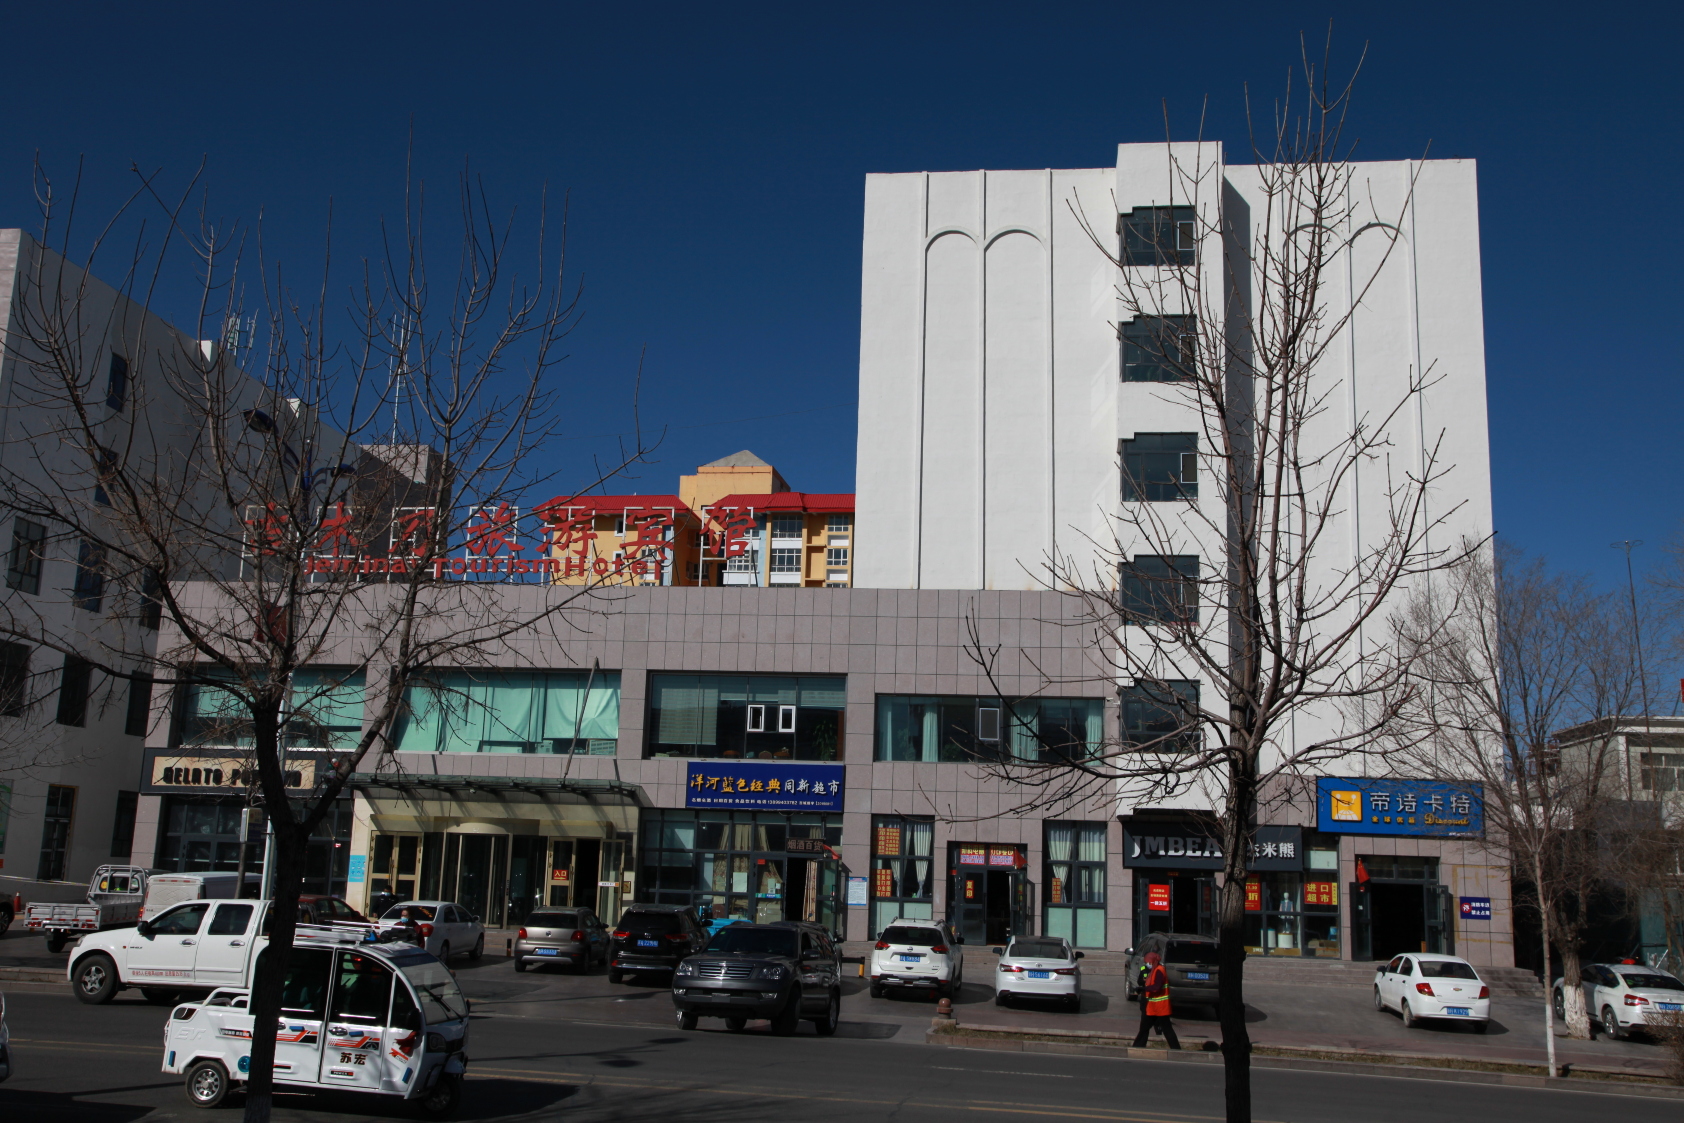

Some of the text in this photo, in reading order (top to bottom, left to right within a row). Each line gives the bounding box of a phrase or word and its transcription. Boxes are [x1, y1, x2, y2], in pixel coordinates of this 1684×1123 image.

[245, 501, 757, 560] 吉木乃旅游宾馆
[564, 556, 662, 579] Hotel
[1369, 791, 1470, 814] 帝诗卡特
[787, 839, 823, 851] 烟酒百货
[1131, 835, 1223, 858] JMBEA
[966, 880, 973, 897] 复印
[1306, 883, 1329, 893] 进口
[1306, 893, 1330, 903] 超市
[340, 1052, 368, 1065] 苏宏
